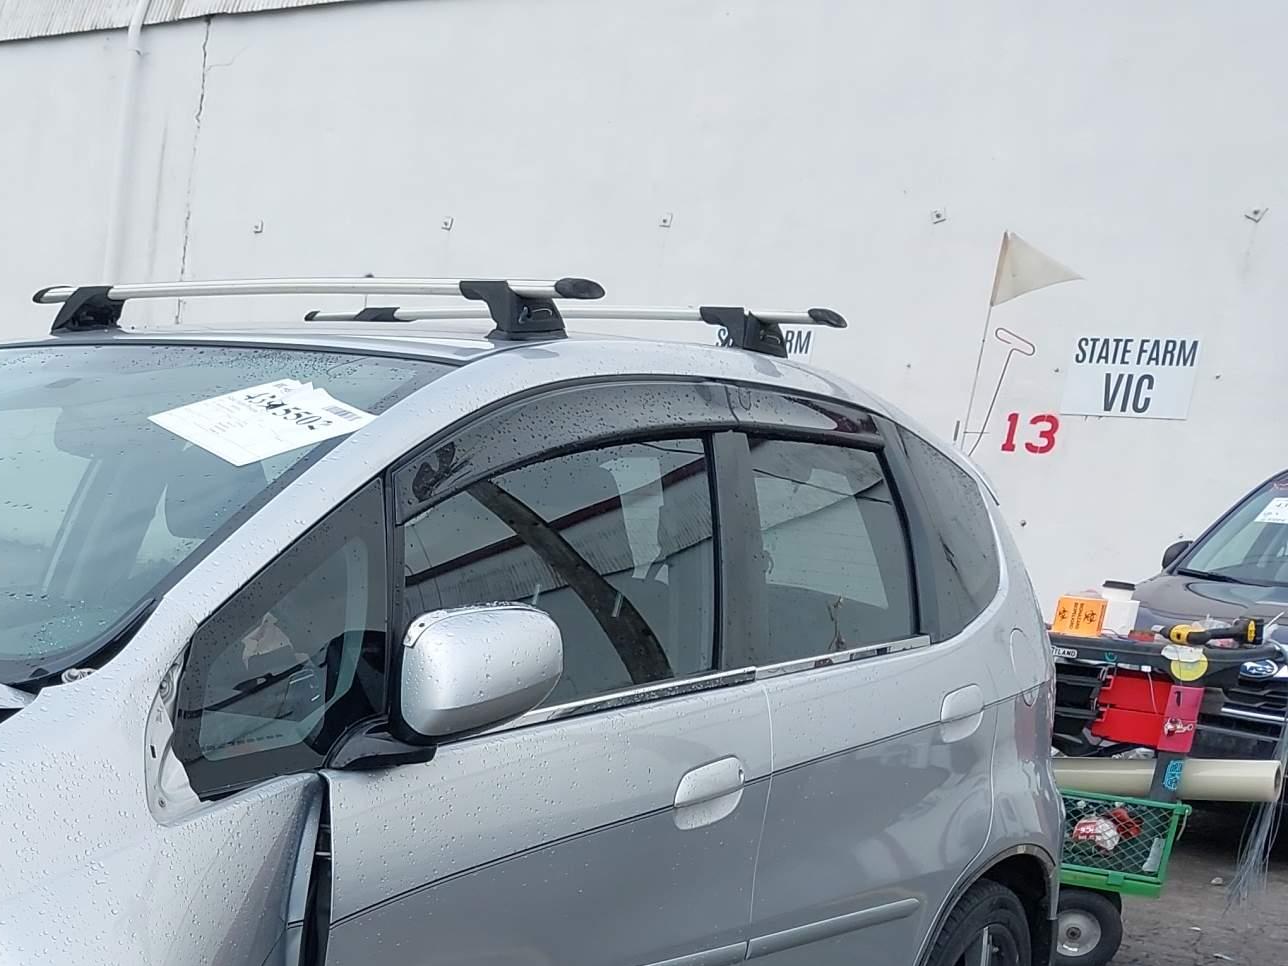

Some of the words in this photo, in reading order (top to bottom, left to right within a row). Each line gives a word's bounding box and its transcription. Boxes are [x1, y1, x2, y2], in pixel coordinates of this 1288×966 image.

[784, 330, 812, 355] RM
[1074, 337, 1134, 365] STATE
[1136, 338, 1199, 367] FARM
[1103, 372, 1155, 414] VIC
[1001, 412, 1060, 454] 13
